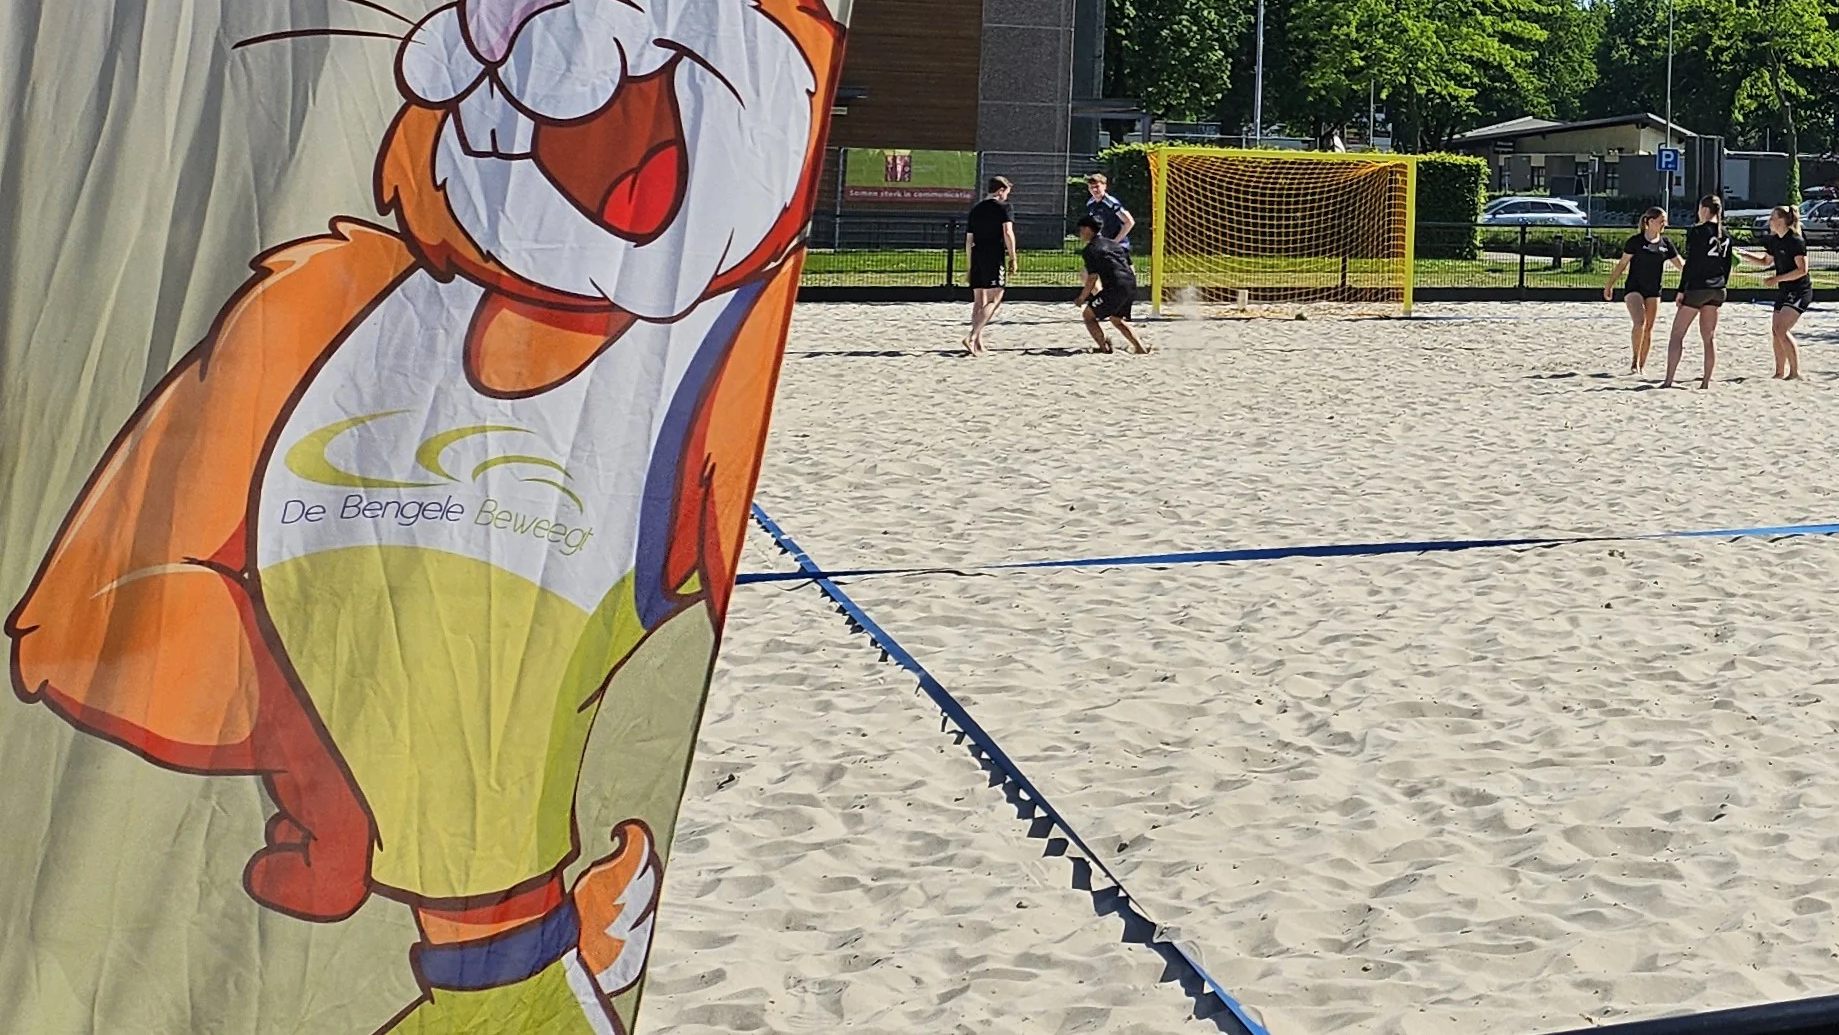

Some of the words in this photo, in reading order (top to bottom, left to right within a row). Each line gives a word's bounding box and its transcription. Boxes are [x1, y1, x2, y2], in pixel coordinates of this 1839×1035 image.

[1661, 150, 1674, 169] P
[281, 499, 327, 525] De
[340, 494, 465, 527] Bengele
[474, 498, 594, 556] Beweegt
